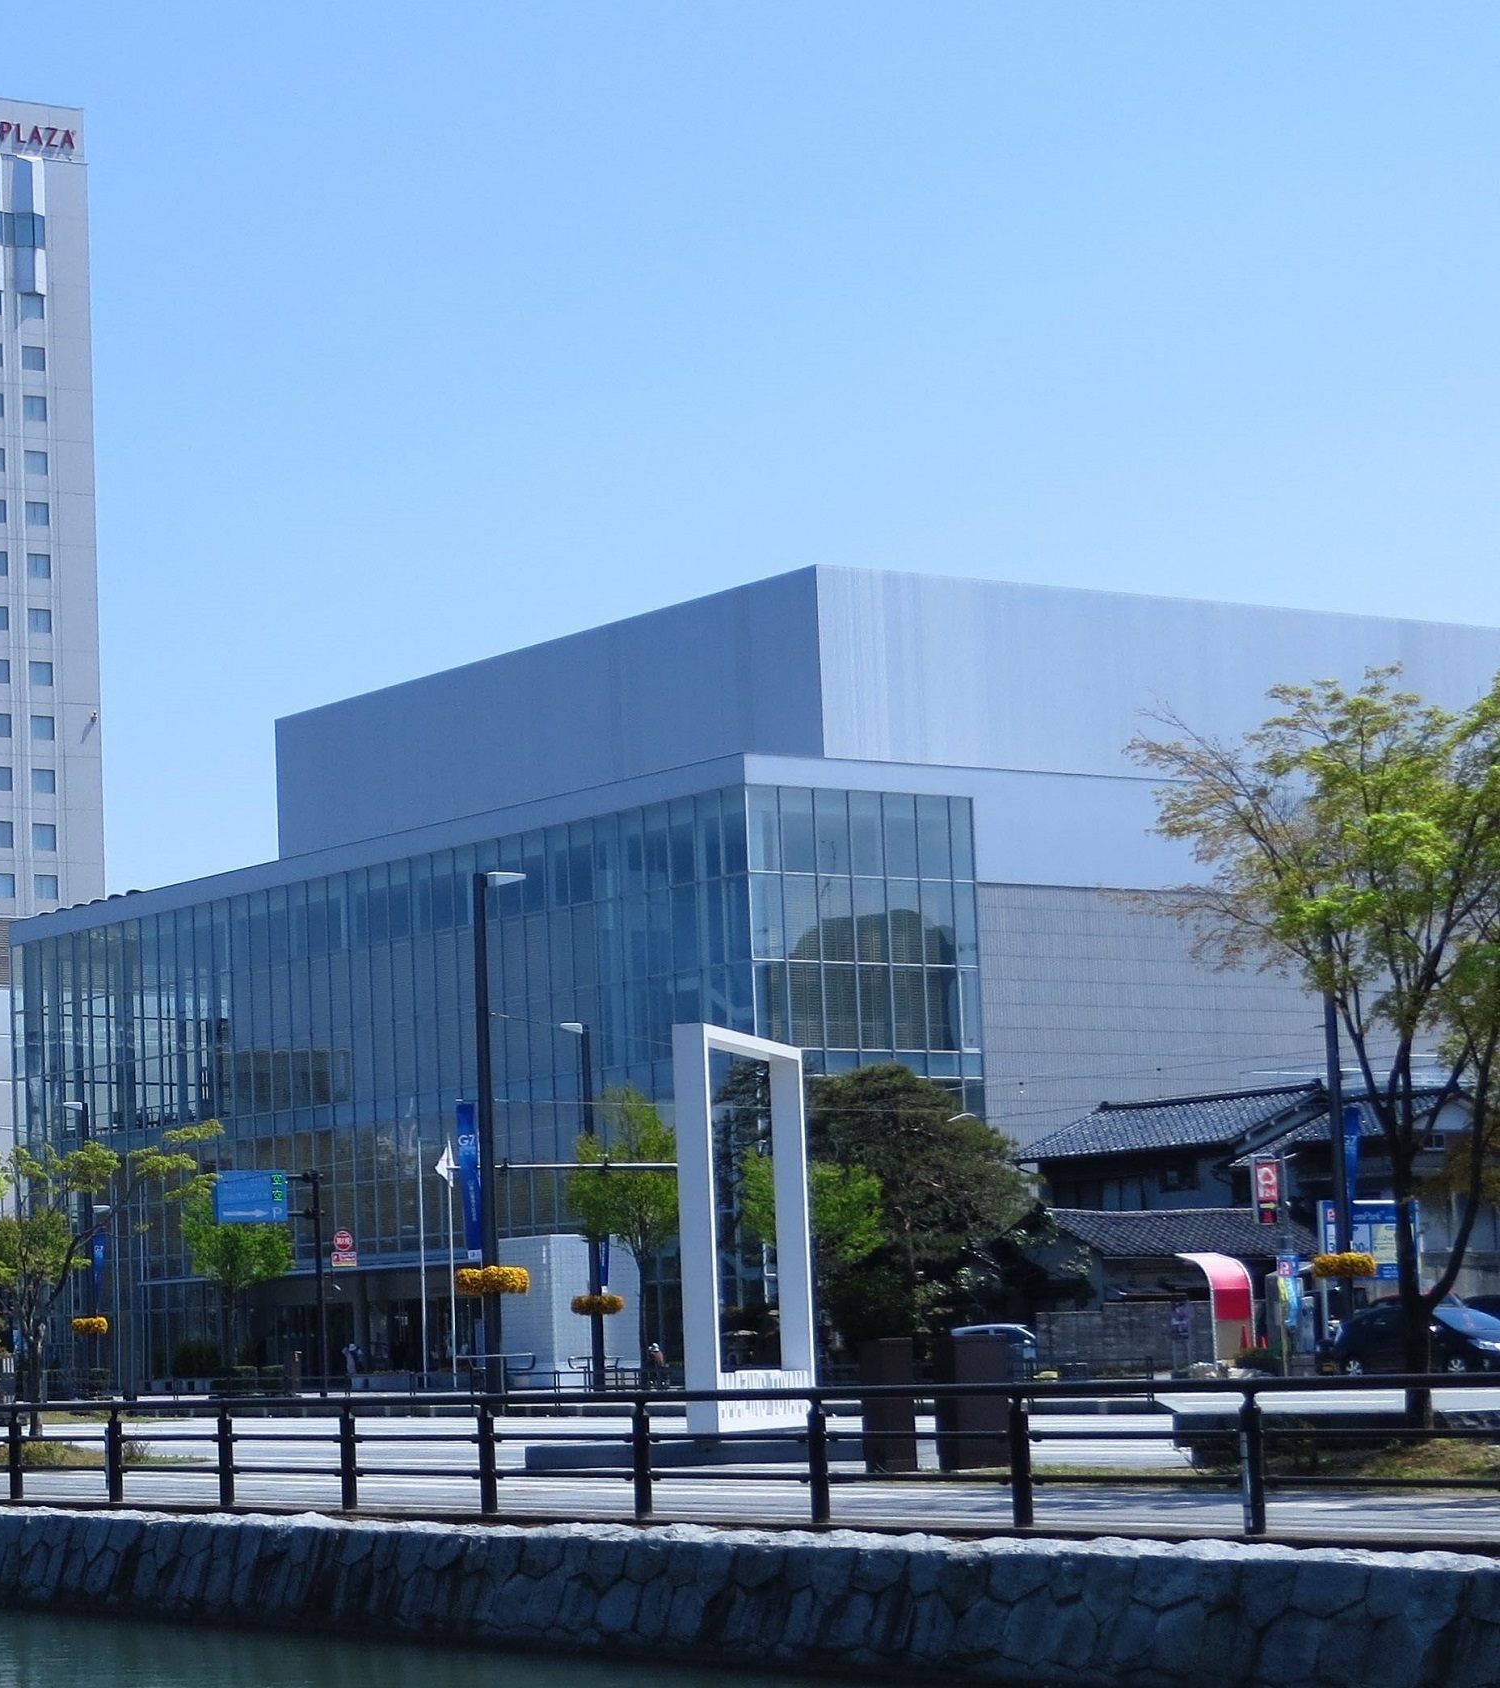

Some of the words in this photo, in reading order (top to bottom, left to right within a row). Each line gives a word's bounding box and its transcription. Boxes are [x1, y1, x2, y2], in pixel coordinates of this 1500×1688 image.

[0, 121, 76, 150] PLAZA
[458, 1134, 476, 1146] G7
[271, 1173, 283, 1185] 空
[271, 1189, 283, 1201] 空
[272, 1206, 283, 1219] P
